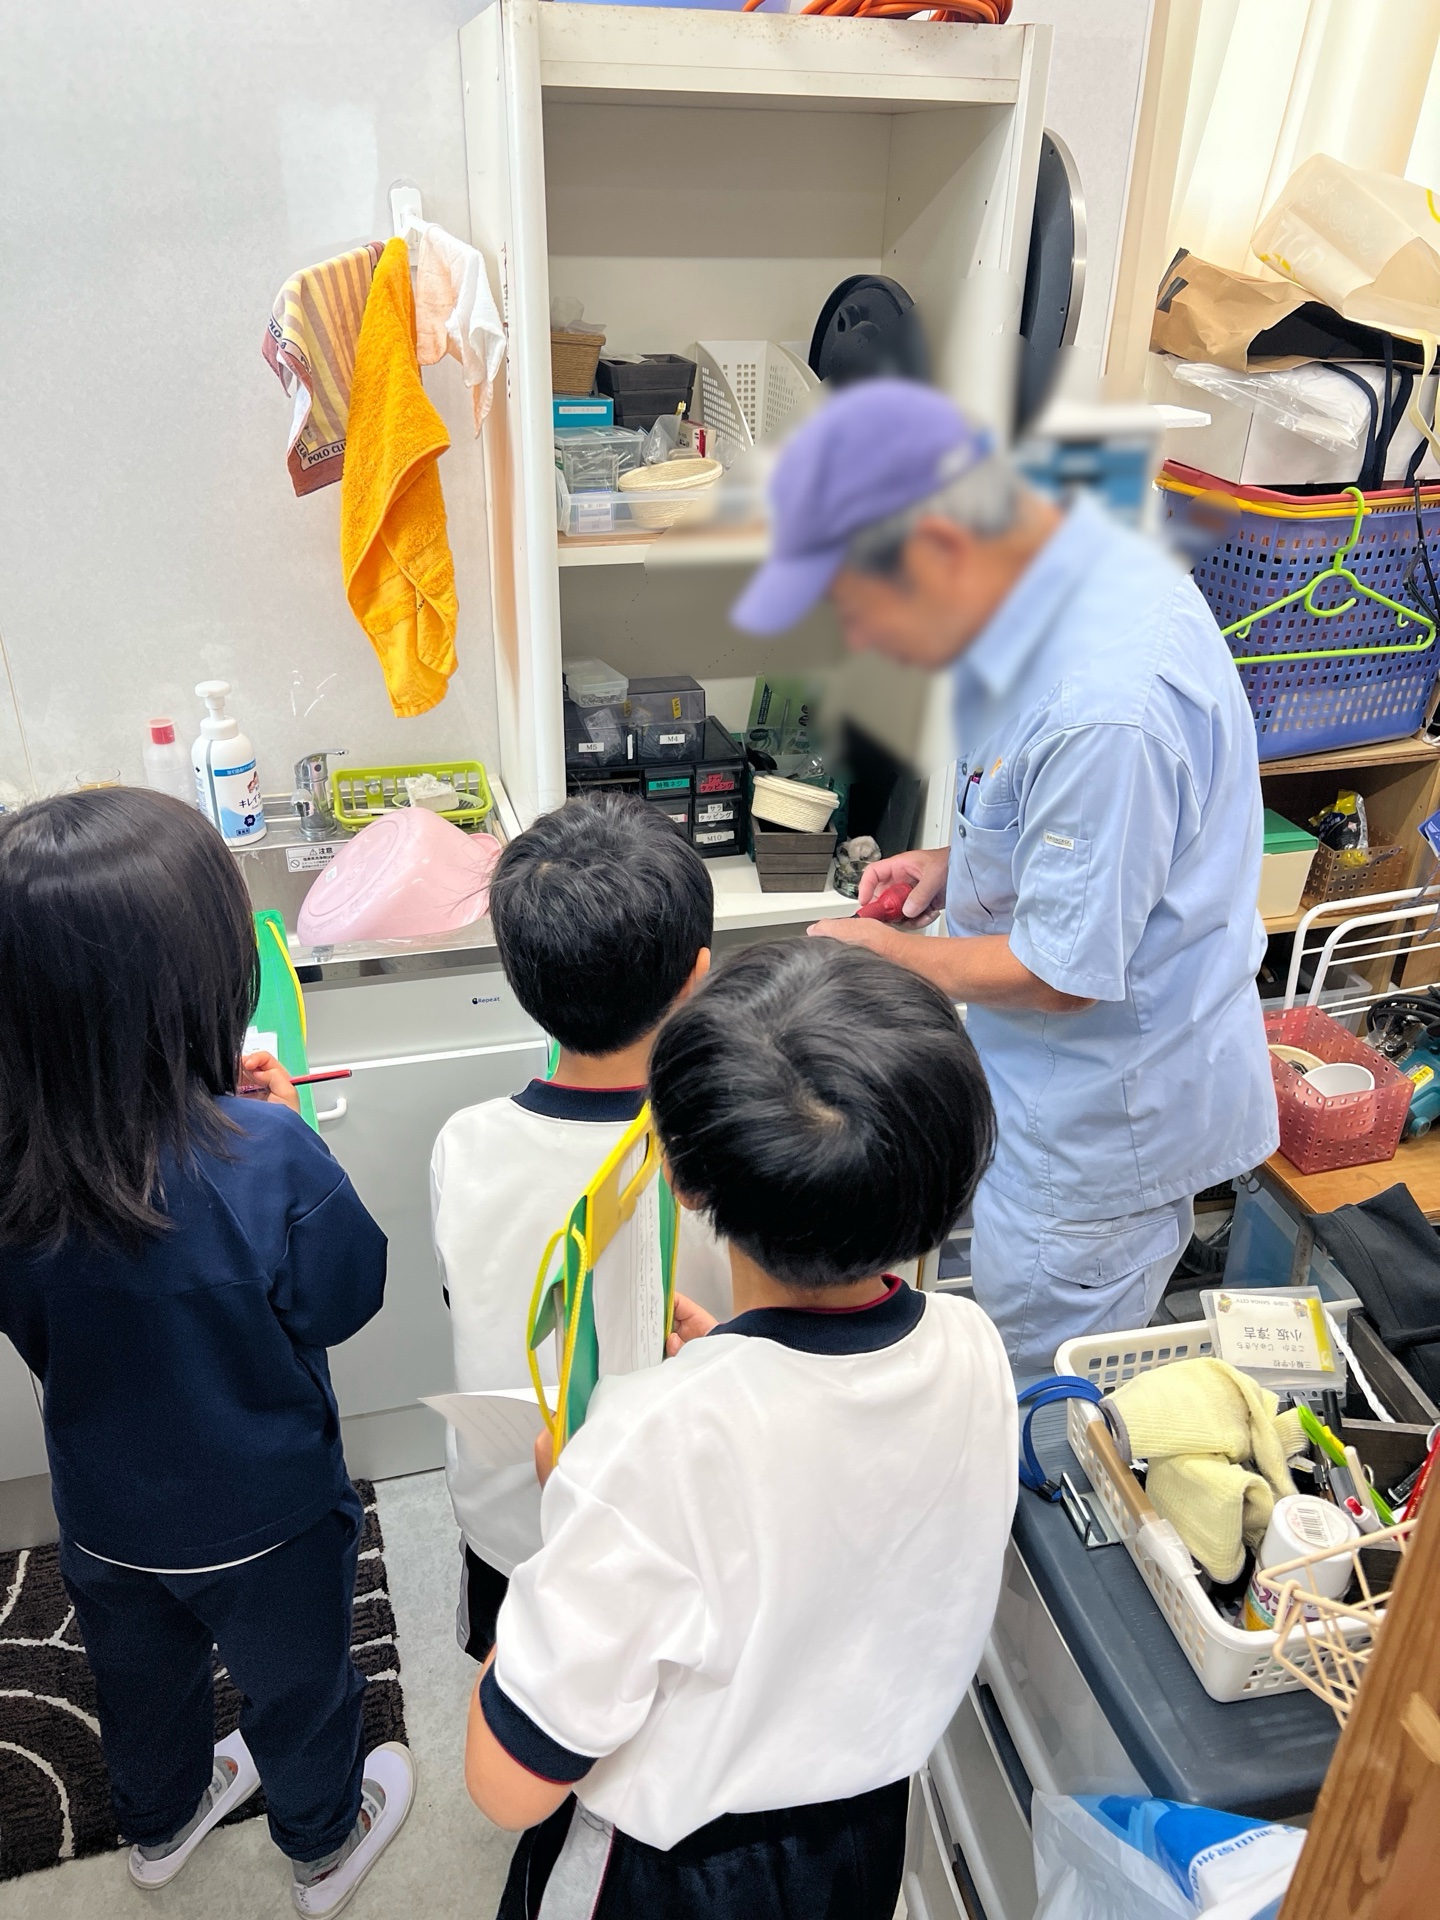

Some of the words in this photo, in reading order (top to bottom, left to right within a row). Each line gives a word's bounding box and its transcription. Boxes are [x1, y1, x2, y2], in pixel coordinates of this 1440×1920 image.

[307, 448, 330, 465] POLO
[701, 782, 734, 792] タッピング
[699, 812, 732, 821] タッピング
[706, 834, 722, 842] M10
[1276, 1328, 1302, 1342] 小坂
